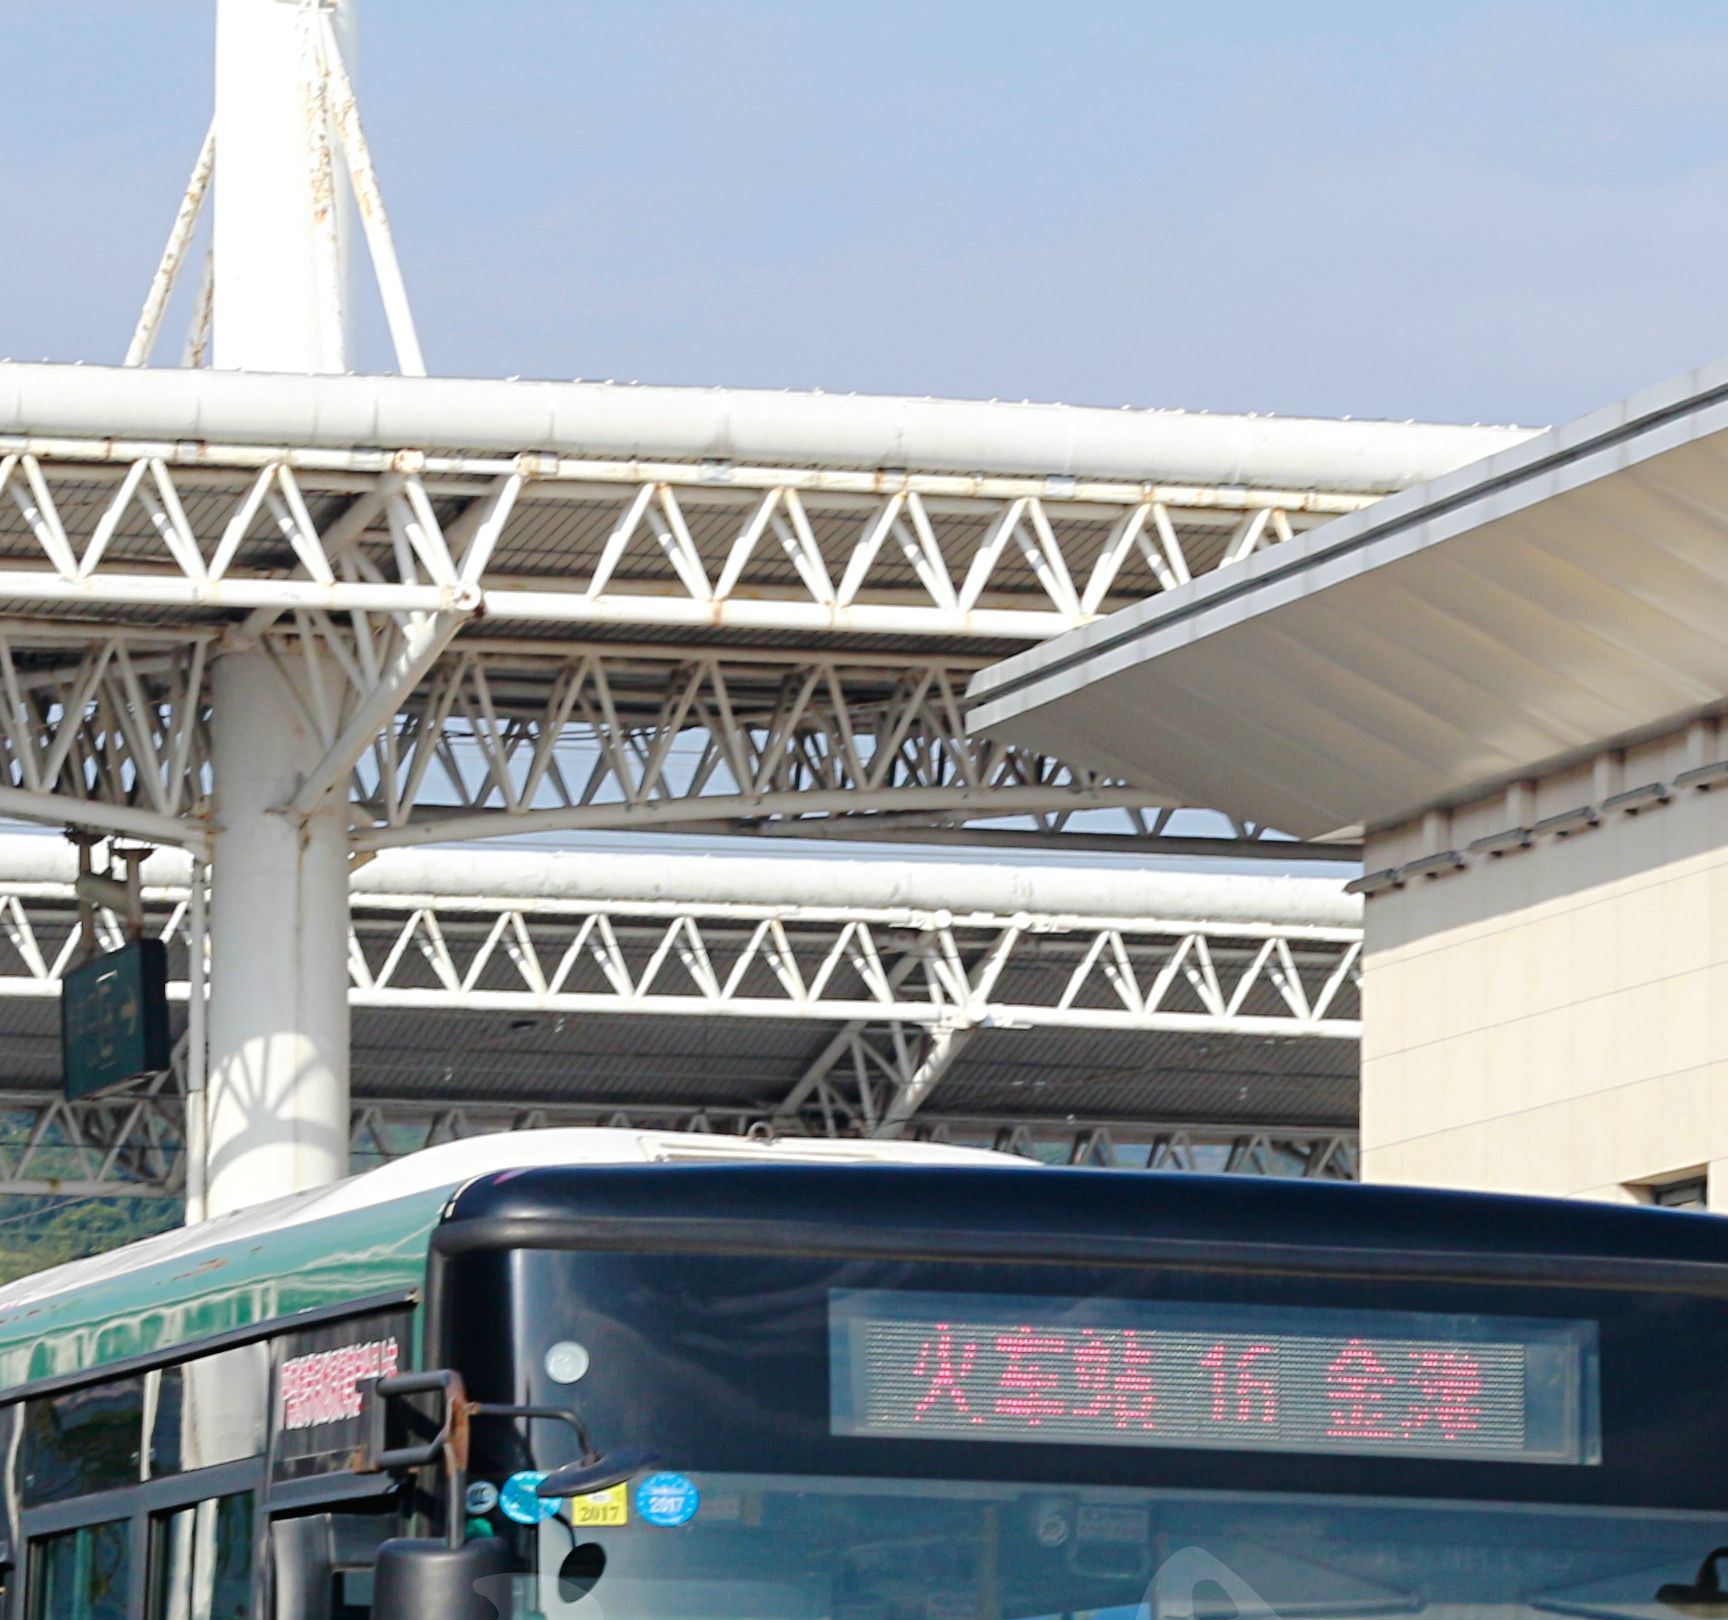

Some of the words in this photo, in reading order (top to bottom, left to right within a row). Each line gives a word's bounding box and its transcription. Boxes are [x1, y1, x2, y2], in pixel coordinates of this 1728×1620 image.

[912, 1323, 1158, 1430] 火车站
[1200, 1344, 1277, 1425] 16
[1326, 1338, 1484, 1439] 金滩
[579, 1505, 622, 1523] 2017
